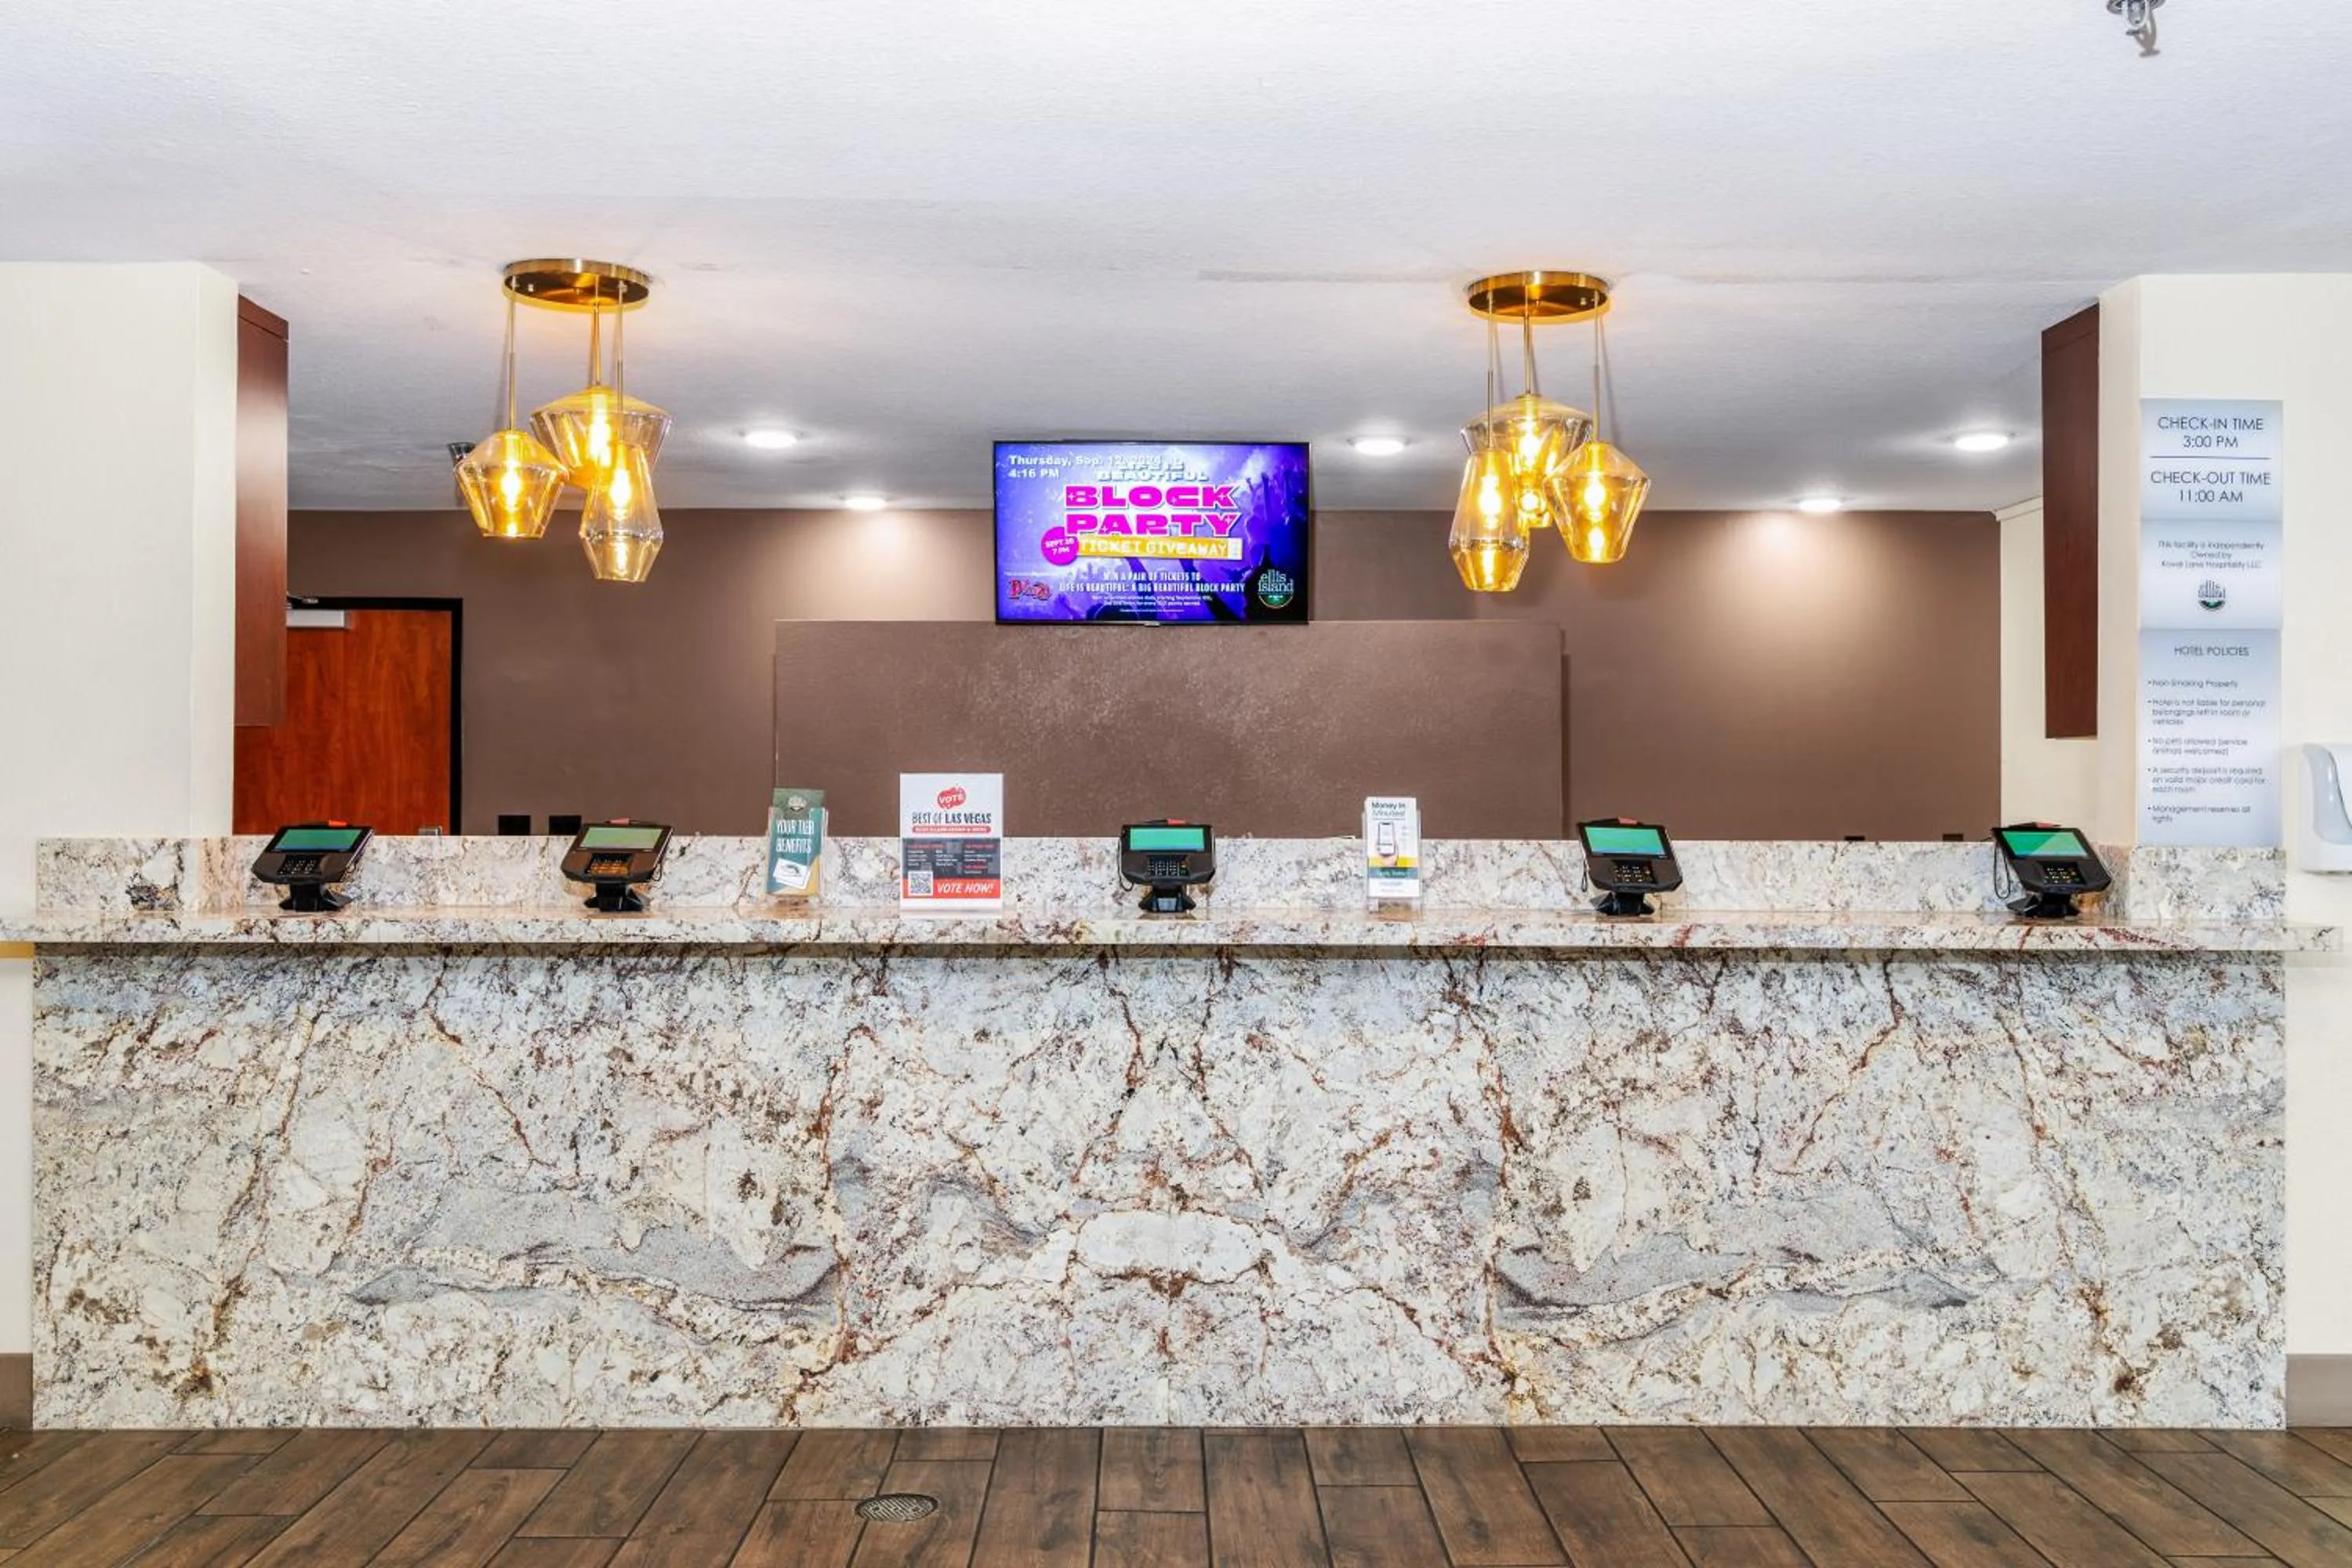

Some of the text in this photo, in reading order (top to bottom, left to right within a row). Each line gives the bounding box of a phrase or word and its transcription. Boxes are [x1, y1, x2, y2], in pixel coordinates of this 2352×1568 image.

[2157, 416, 2263, 430] CHECK-IN TIME
[2183, 435, 2238, 448] 3:00 PM
[1009, 455, 1072, 466] Thursday,
[1076, 455, 1103, 466] Sep.
[1008, 468, 1060, 477] 4:16 PM
[2151, 471, 2271, 485] CHECK-OUT TIME
[1065, 485, 1236, 507] BLOCK
[2180, 489, 2243, 503] 11:00 AM
[1065, 513, 1239, 536] PARTY
[1080, 538, 1142, 554] TICKET
[1120, 572, 1127, 581] A
[1160, 572, 1190, 581] TICKETS
[1260, 568, 1287, 582] ellis
[1059, 583, 1075, 592] LIFE
[1076, 583, 1084, 592] IS
[1138, 583, 1152, 592] BIG
[1153, 583, 1193, 592] BEAUTIFUL
[1196, 583, 1219, 593] BLOCK
[1221, 583, 1246, 593] PARTY
[2174, 646, 2250, 657] HOTEL POLICIES
[2205, 680, 2238, 688] Property
[938, 793, 964, 804] VOTE
[912, 811, 931, 823] BEST
[945, 811, 962, 823] LAS
[964, 811, 992, 824] VEGAS
[797, 820, 815, 835] TIER
[775, 838, 812, 854] BENEFITS
[937, 883, 995, 895] VOTE NOW!
